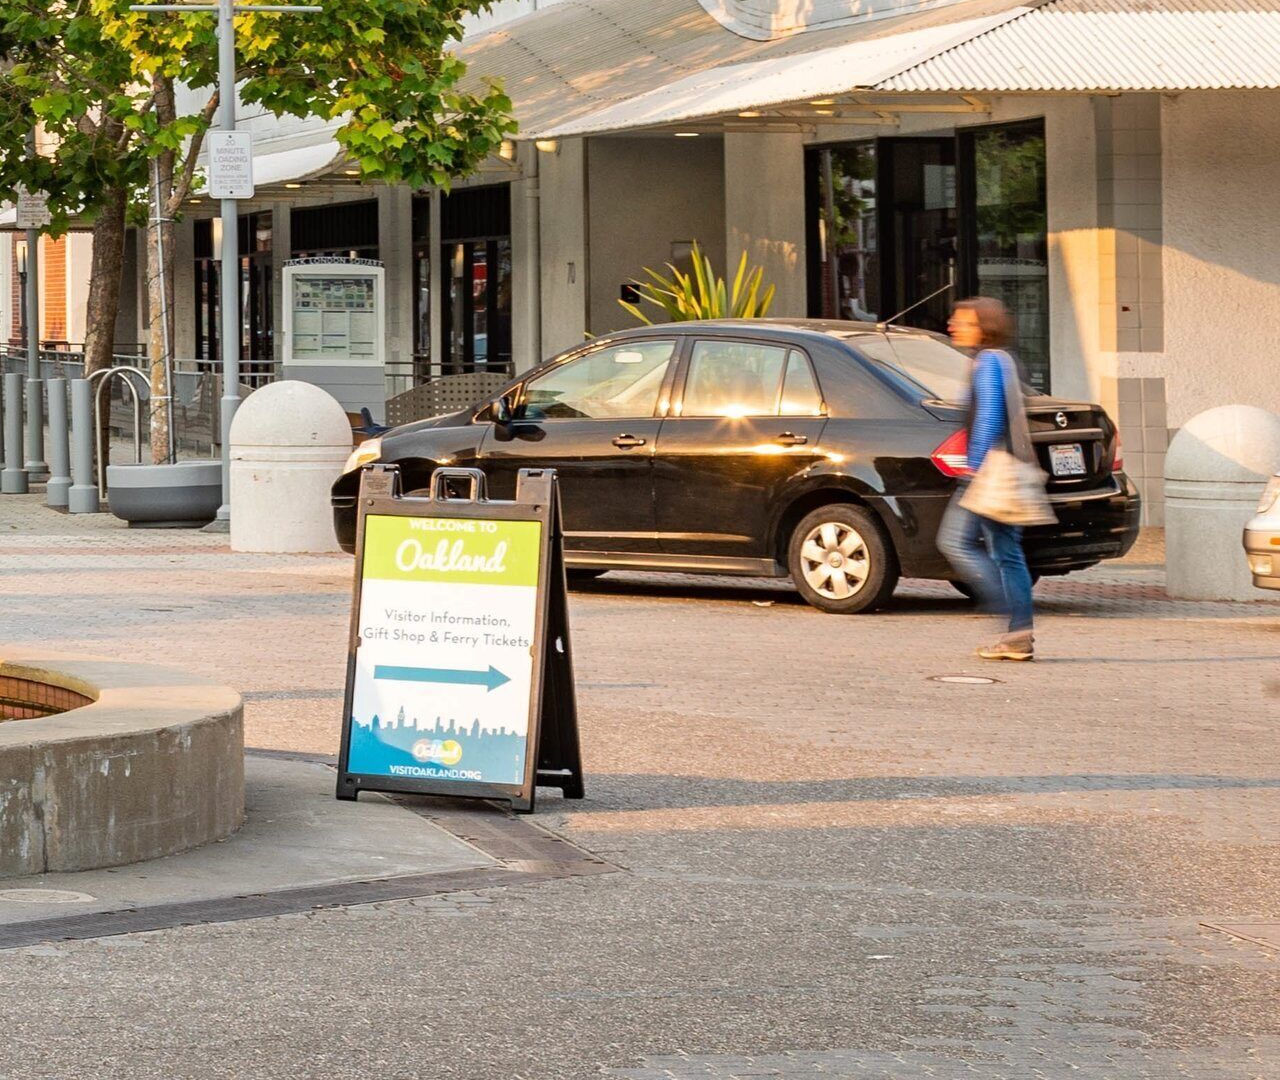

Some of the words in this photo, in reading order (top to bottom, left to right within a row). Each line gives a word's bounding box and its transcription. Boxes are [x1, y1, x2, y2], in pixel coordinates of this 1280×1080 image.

[409, 519, 476, 533] WELCOME
[478, 521, 497, 533] TO
[395, 538, 508, 573] Oakland
[384, 608, 427, 623] Visitor
[430, 611, 511, 628] Information,
[363, 627, 389, 640] Gift
[393, 628, 425, 645] Shop
[429, 631, 440, 643] &
[443, 631, 479, 648] Ferry
[483, 633, 530, 648] Tickets
[389, 764, 482, 781] VISITOAKLAND.ORG
